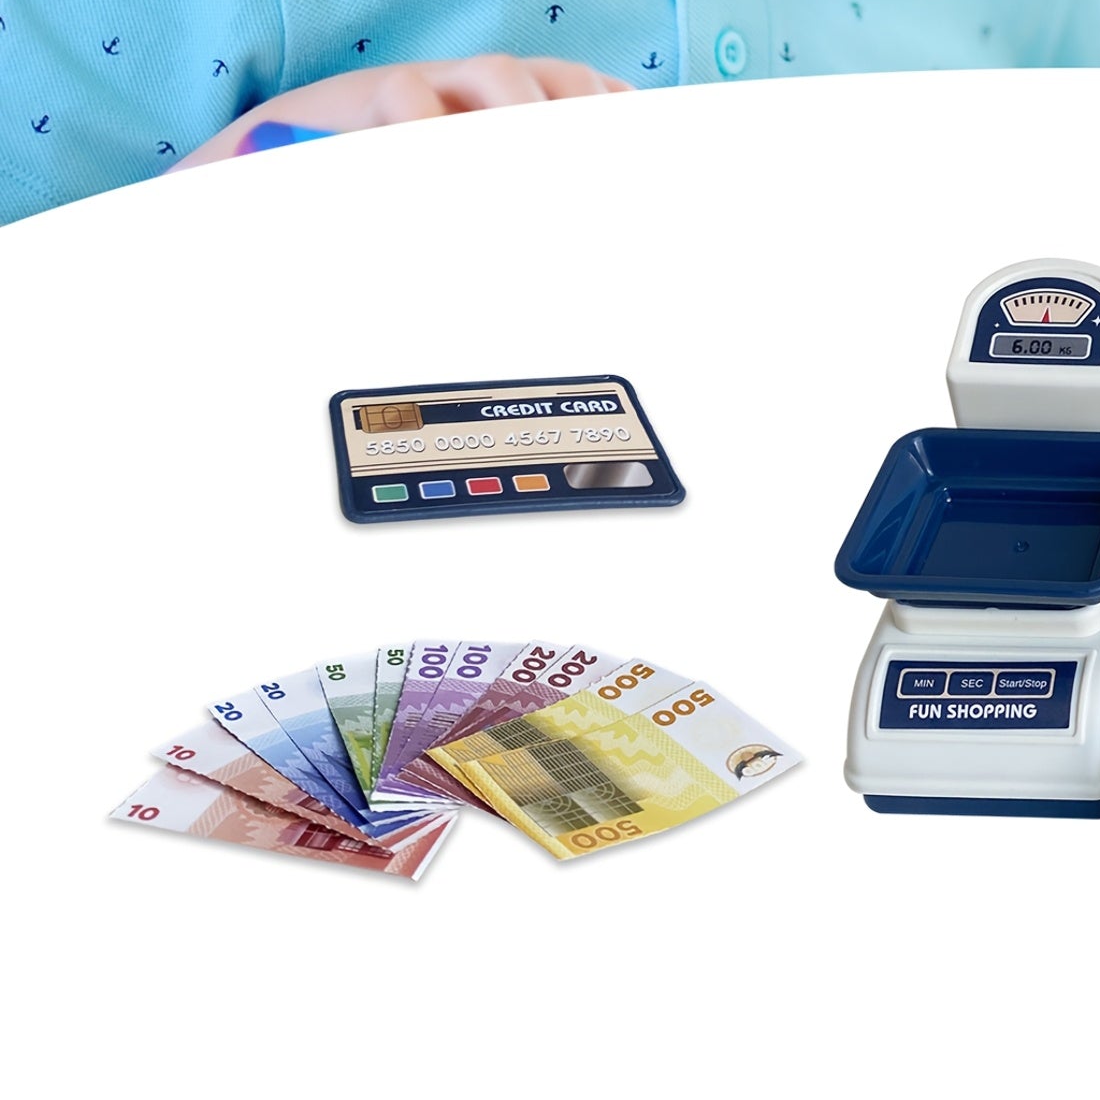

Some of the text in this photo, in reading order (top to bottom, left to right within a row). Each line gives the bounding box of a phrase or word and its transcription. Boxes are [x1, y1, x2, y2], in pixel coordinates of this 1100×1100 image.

[1012, 340, 1052, 355] 6.00
[480, 399, 618, 418] CREDIT CARD
[365, 426, 631, 455] 5850 0000 4567 7890
[386, 649, 404, 666] 50
[418, 645, 449, 679] 100
[455, 644, 492, 679] 100
[511, 646, 556, 684] 200
[325, 663, 347, 682] 50
[547, 649, 599, 689] 200
[260, 682, 286, 701] 20
[597, 663, 656, 701] 500
[914, 679, 1047, 690] MIN SEC Start/Stop
[214, 701, 243, 722] 20
[651, 688, 716, 727] 500
[909, 704, 1037, 719] FUN SHOPPING
[165, 744, 196, 761] 10
[128, 804, 160, 821] 10
[570, 820, 643, 849] 500
